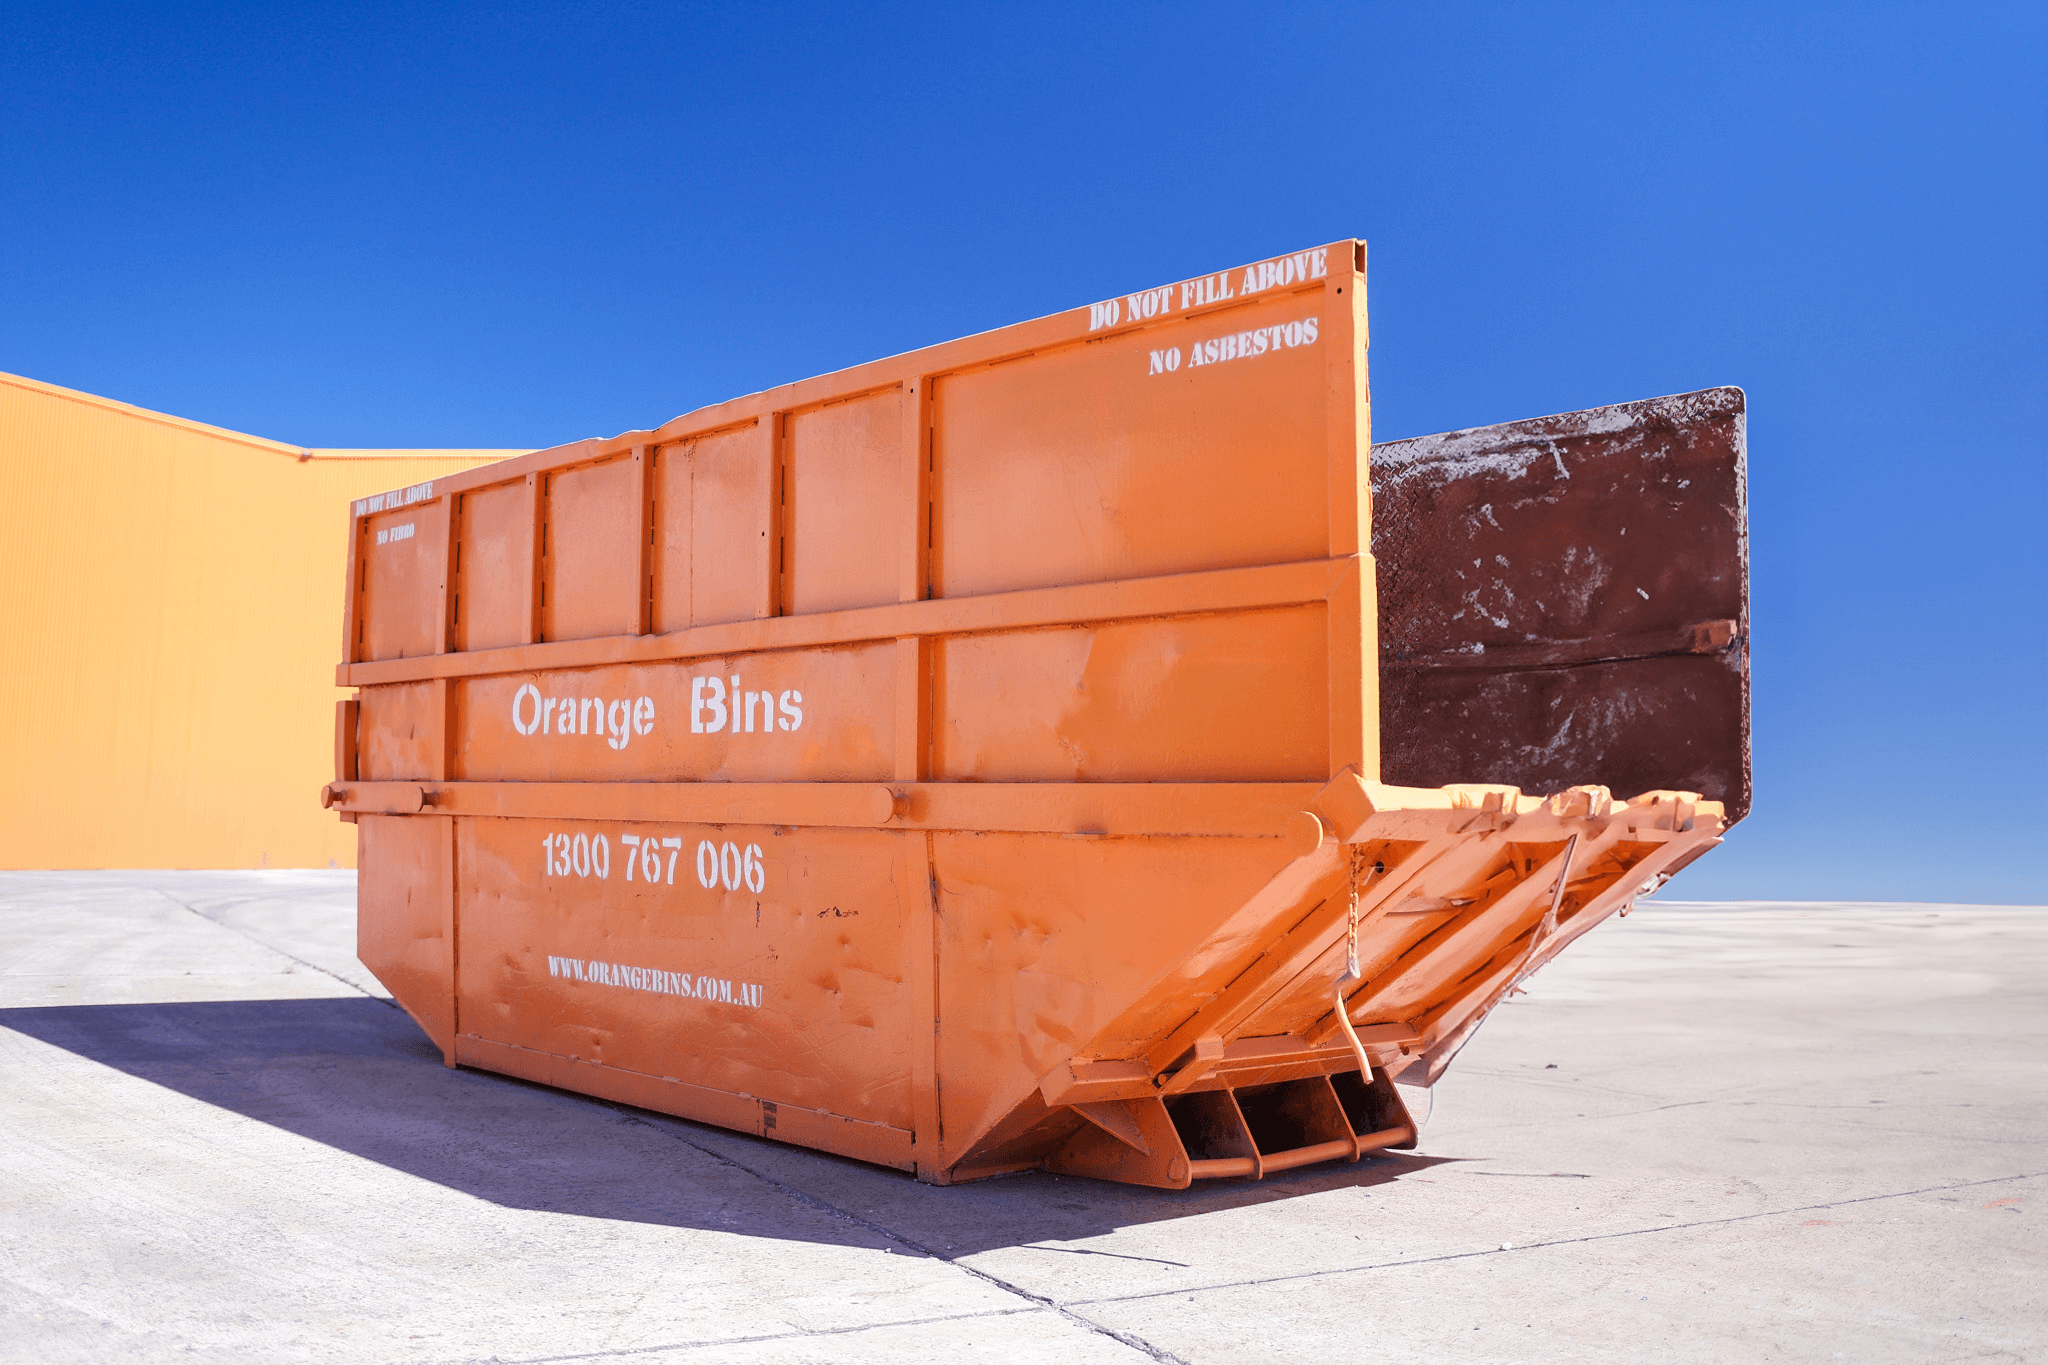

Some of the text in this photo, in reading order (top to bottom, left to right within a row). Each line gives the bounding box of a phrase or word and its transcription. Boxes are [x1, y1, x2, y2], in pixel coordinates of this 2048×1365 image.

[1089, 248, 1328, 332] DO NOT FILL ABOVE
[1148, 317, 1319, 376] NO ASBESTOS
[356, 482, 433, 517] DO NOT FILL ABOVE
[376, 530, 388, 545] NO
[512, 674, 803, 750] Orange Bins
[542, 832, 765, 894] 1300 767 006
[547, 955, 763, 1009] WWW.ORANGEBINS.COM.AU
